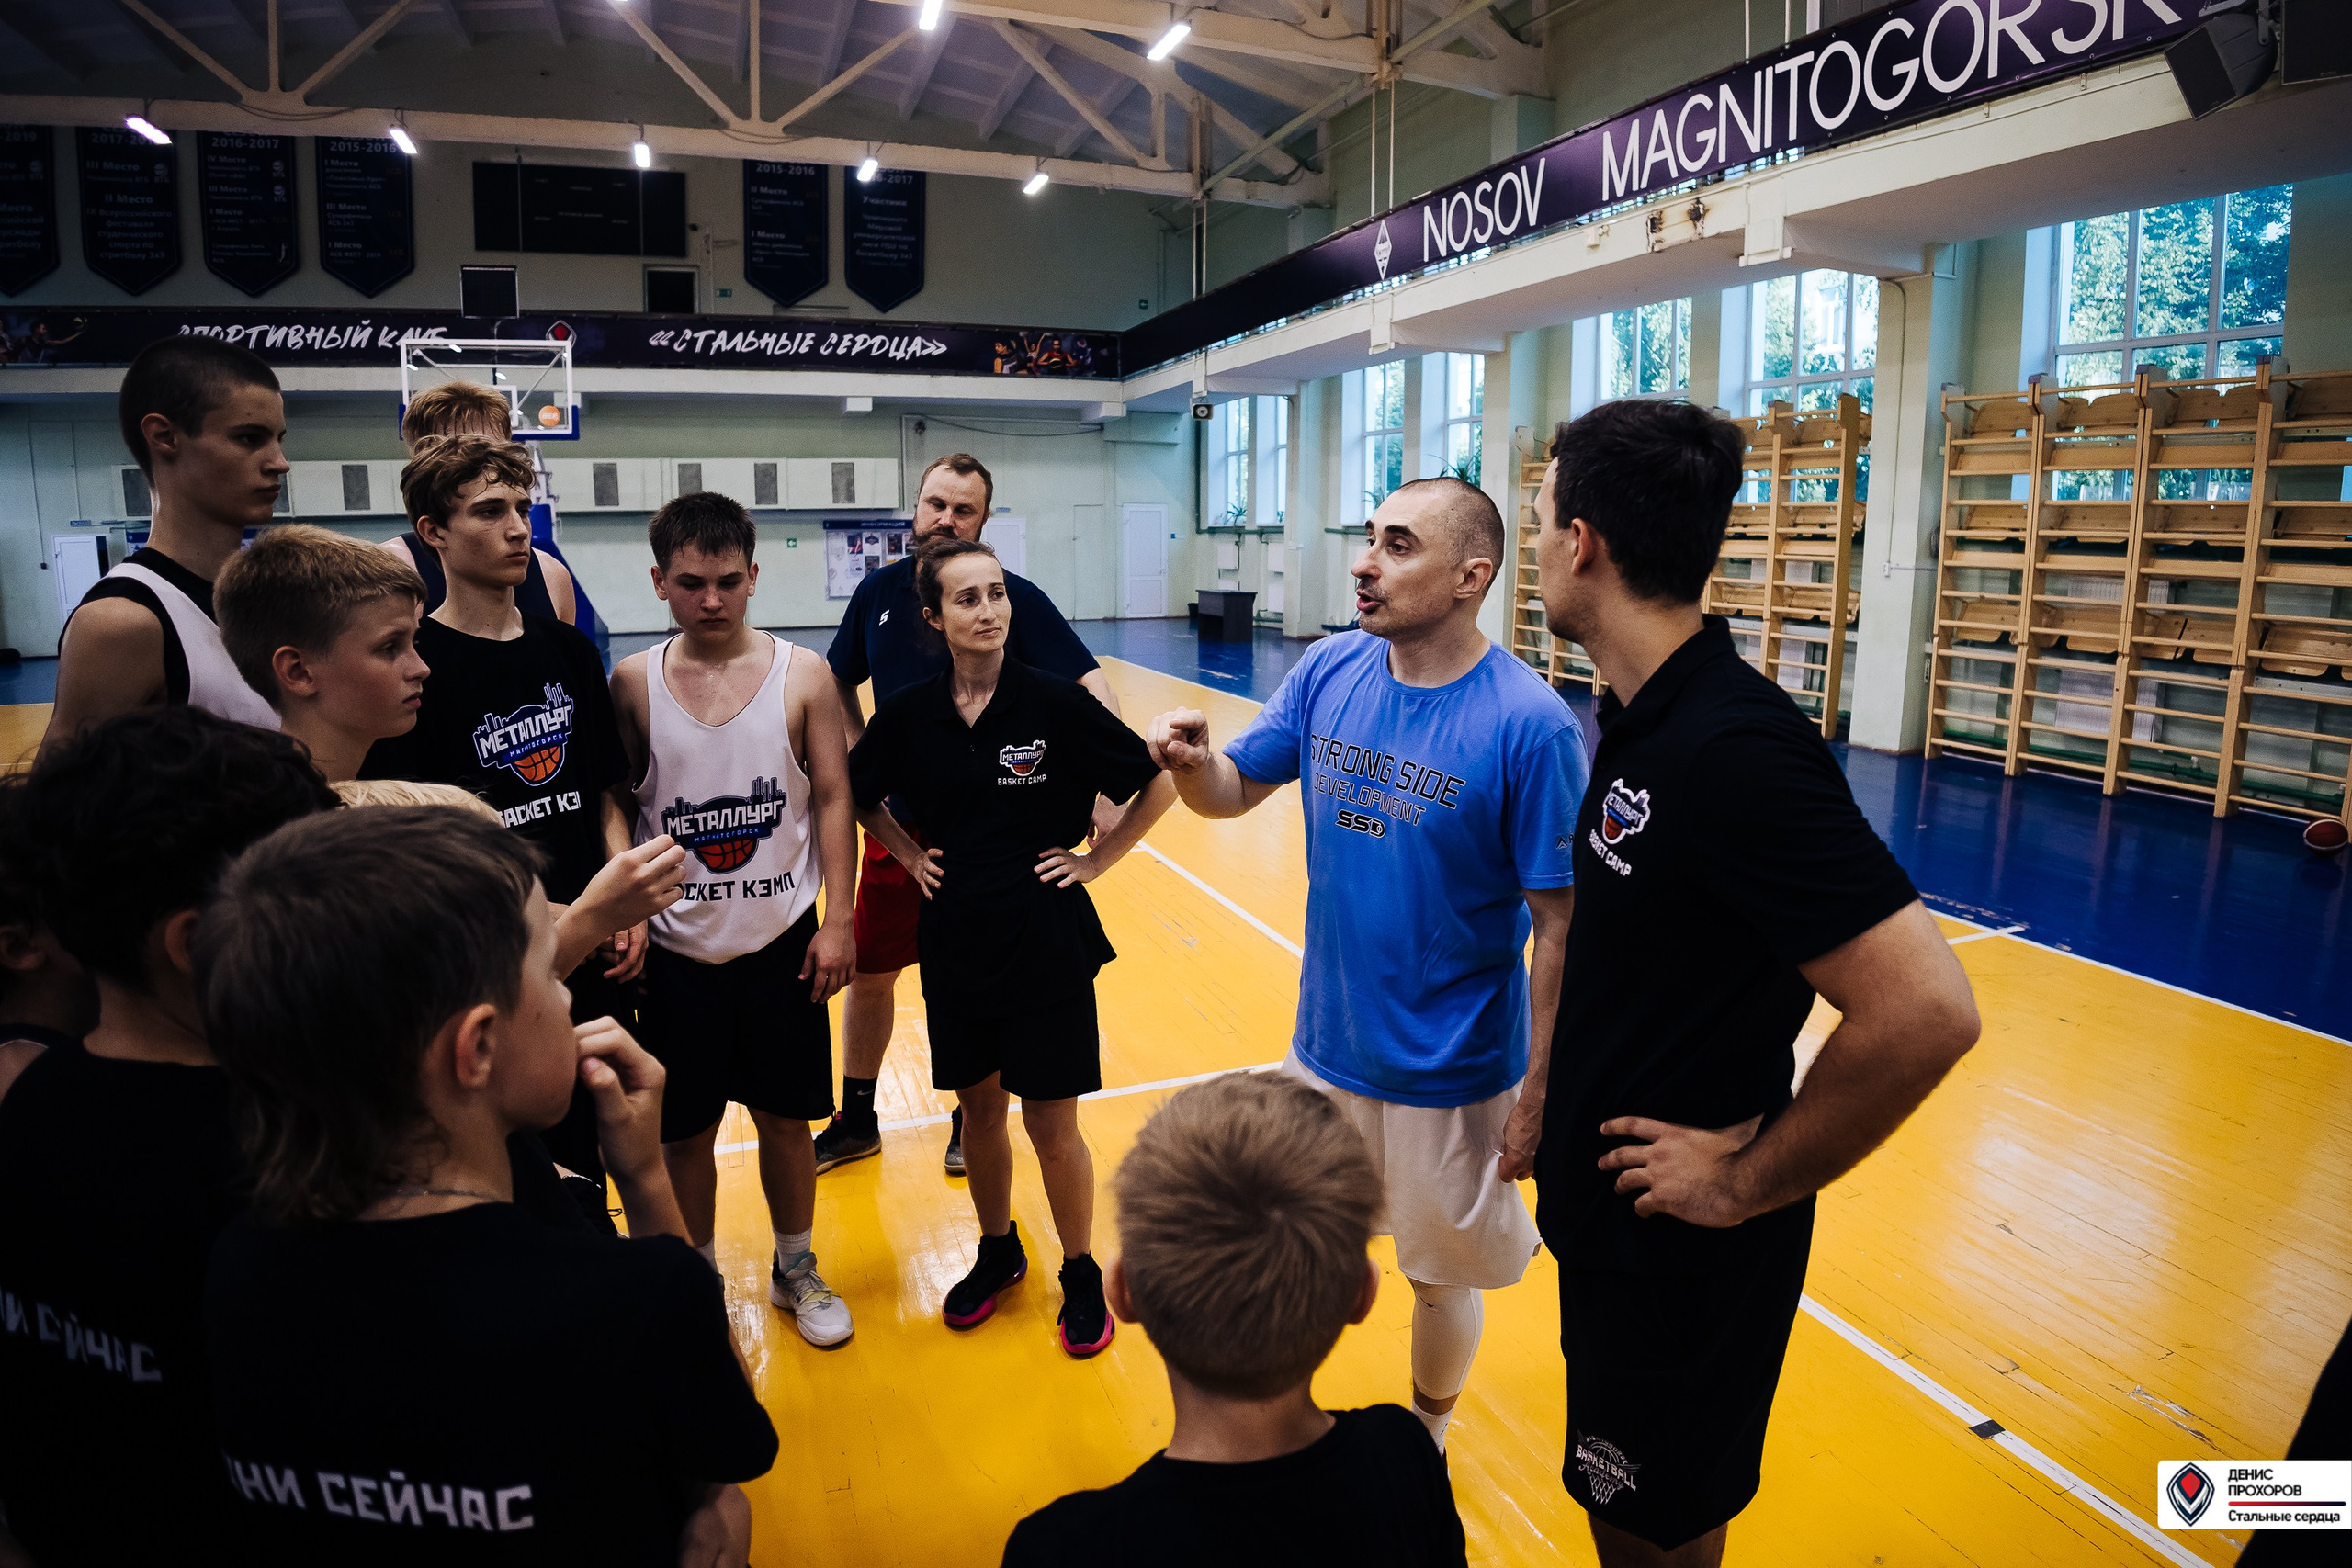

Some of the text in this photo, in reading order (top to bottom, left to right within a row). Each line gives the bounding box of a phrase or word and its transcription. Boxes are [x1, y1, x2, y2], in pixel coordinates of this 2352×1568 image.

[92, 132, 151, 145] 2017-20
[212, 137, 279, 149] 2016-2017
[330, 141, 397, 153] 2015-2016
[103, 161, 140, 171] Место
[330, 159, 359, 167] Место
[756, 163, 816, 175] 2015-2016
[760, 186, 788, 196] Место
[105, 194, 153, 204] II Место
[215, 208, 243, 216] Место
[1423, 158, 1545, 262] NOSOV
[757, 231, 786, 239] Место
[334, 241, 362, 249] Место
[820, 332, 947, 362] СЕРДЦА»
[479, 704, 571, 759] МЕТАЛЛУРГ
[509, 733, 563, 757] МАГНИТОГОРСК
[997, 773, 1047, 786] BASKET CAMP
[1395, 760, 1466, 809] SIDE
[498, 790, 582, 829] АСКЕТ КЭ
[666, 799, 783, 837] МЕТАЛЛУРГ
[695, 828, 759, 842] МАГНИТОГОРСК
[1605, 850, 1633, 877] CAMP
[673, 871, 795, 901] СКЕТ КЭМП
[315, 1468, 535, 1533] СЕЙЧАС
